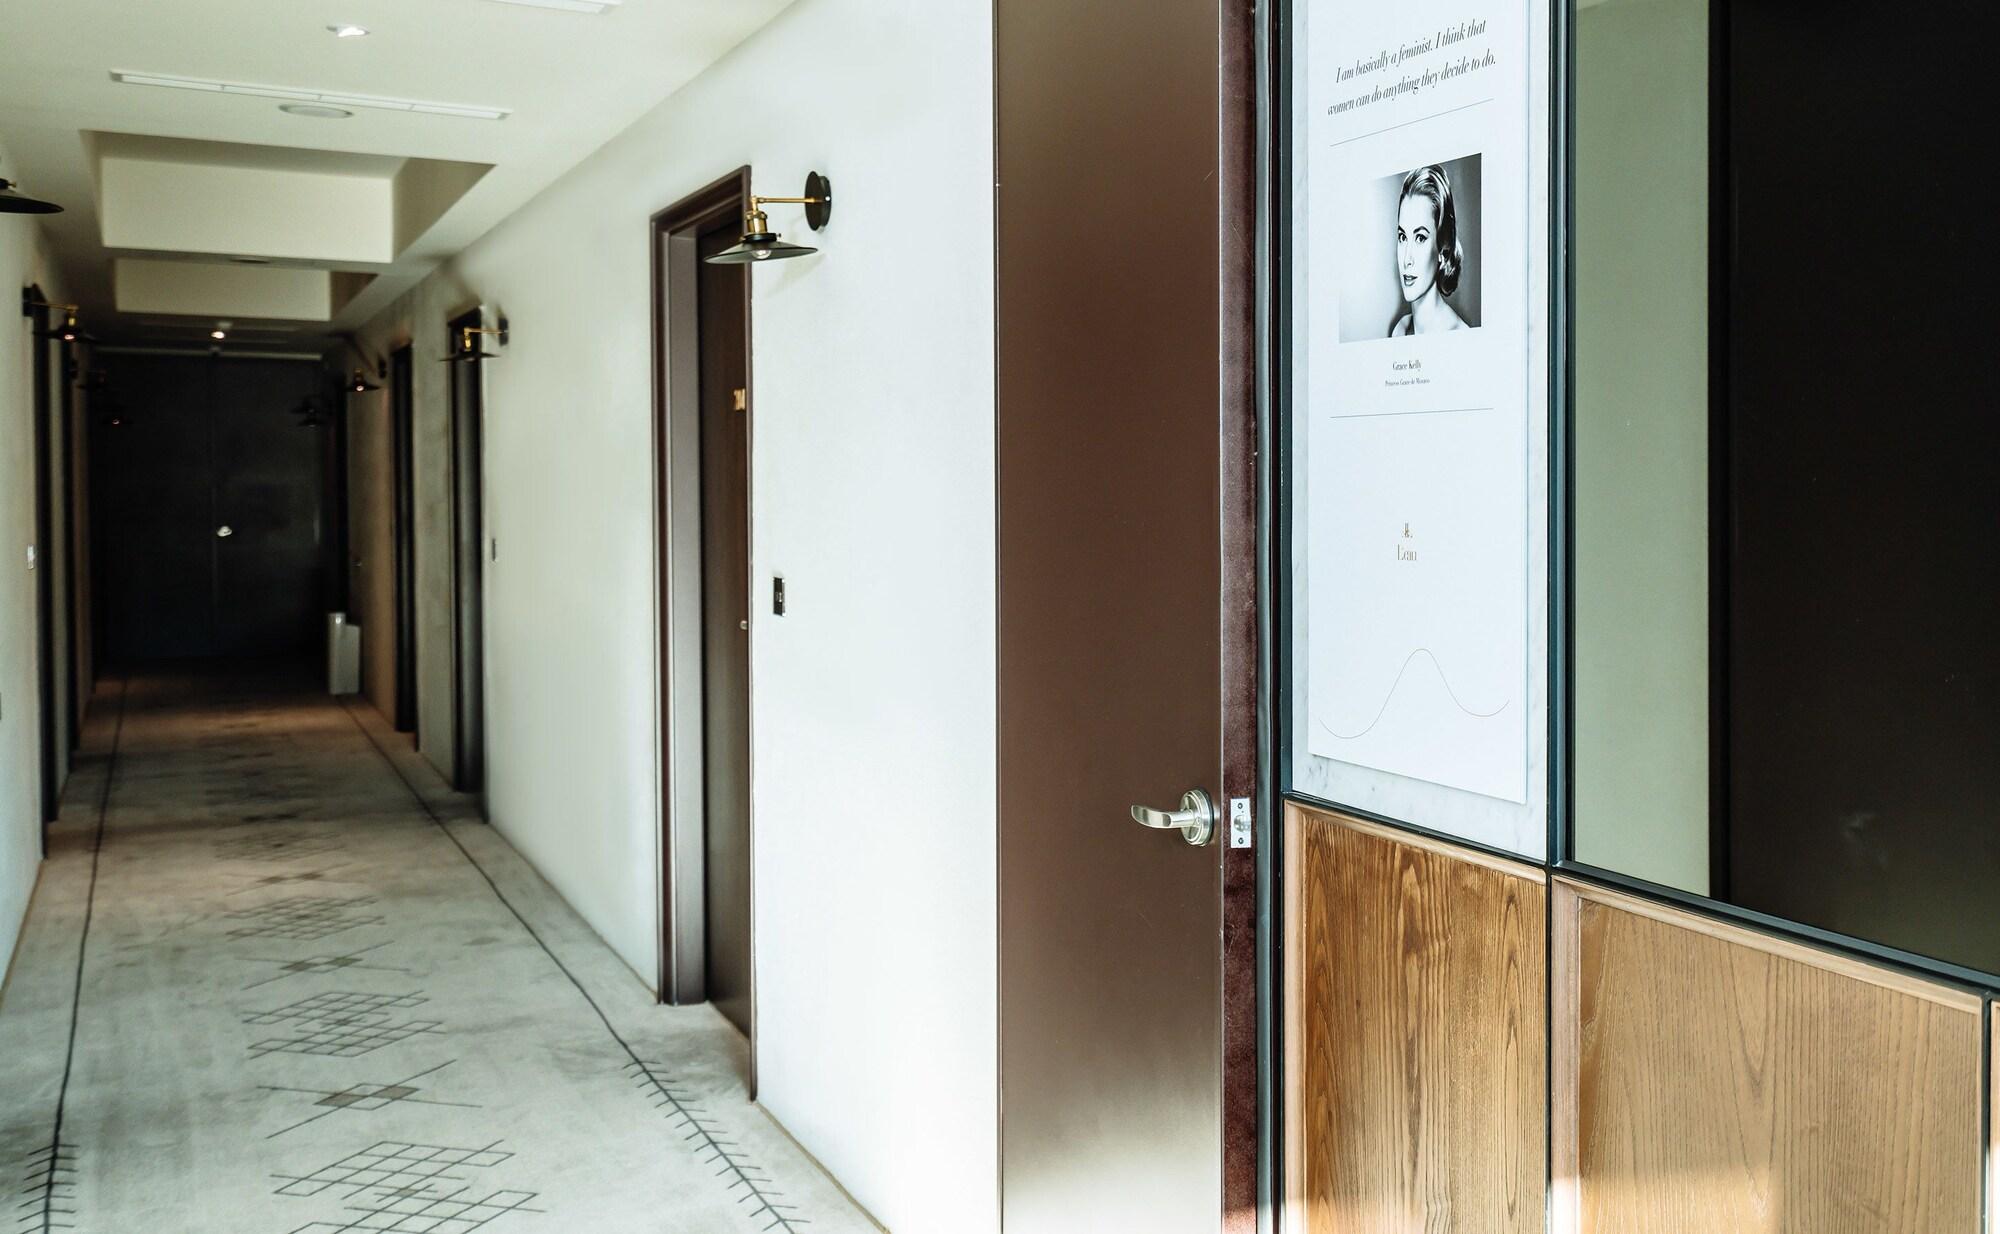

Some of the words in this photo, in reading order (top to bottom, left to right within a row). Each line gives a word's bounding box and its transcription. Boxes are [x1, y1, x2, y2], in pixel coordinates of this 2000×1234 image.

[1327, 98, 1355, 116] women
[1355, 94, 1370, 107] can
[1371, 84, 1382, 103] do
[1382, 75, 1420, 101] anything
[1421, 67, 1440, 88] they
[1440, 56, 1469, 80] decide
[1471, 58, 1480, 71] to
[1481, 48, 1496, 67] do.
[1336, 66, 1341, 83] I
[1341, 69, 1354, 81] am
[1356, 50, 1390, 76] basically
[1390, 53, 1397, 64] a
[1396, 37, 1433, 67] feminist.
[1435, 31, 1441, 49] I
[1441, 22, 1466, 47] think
[1467, 18, 1486, 38] that
[1392, 361, 1408, 371] Grace
